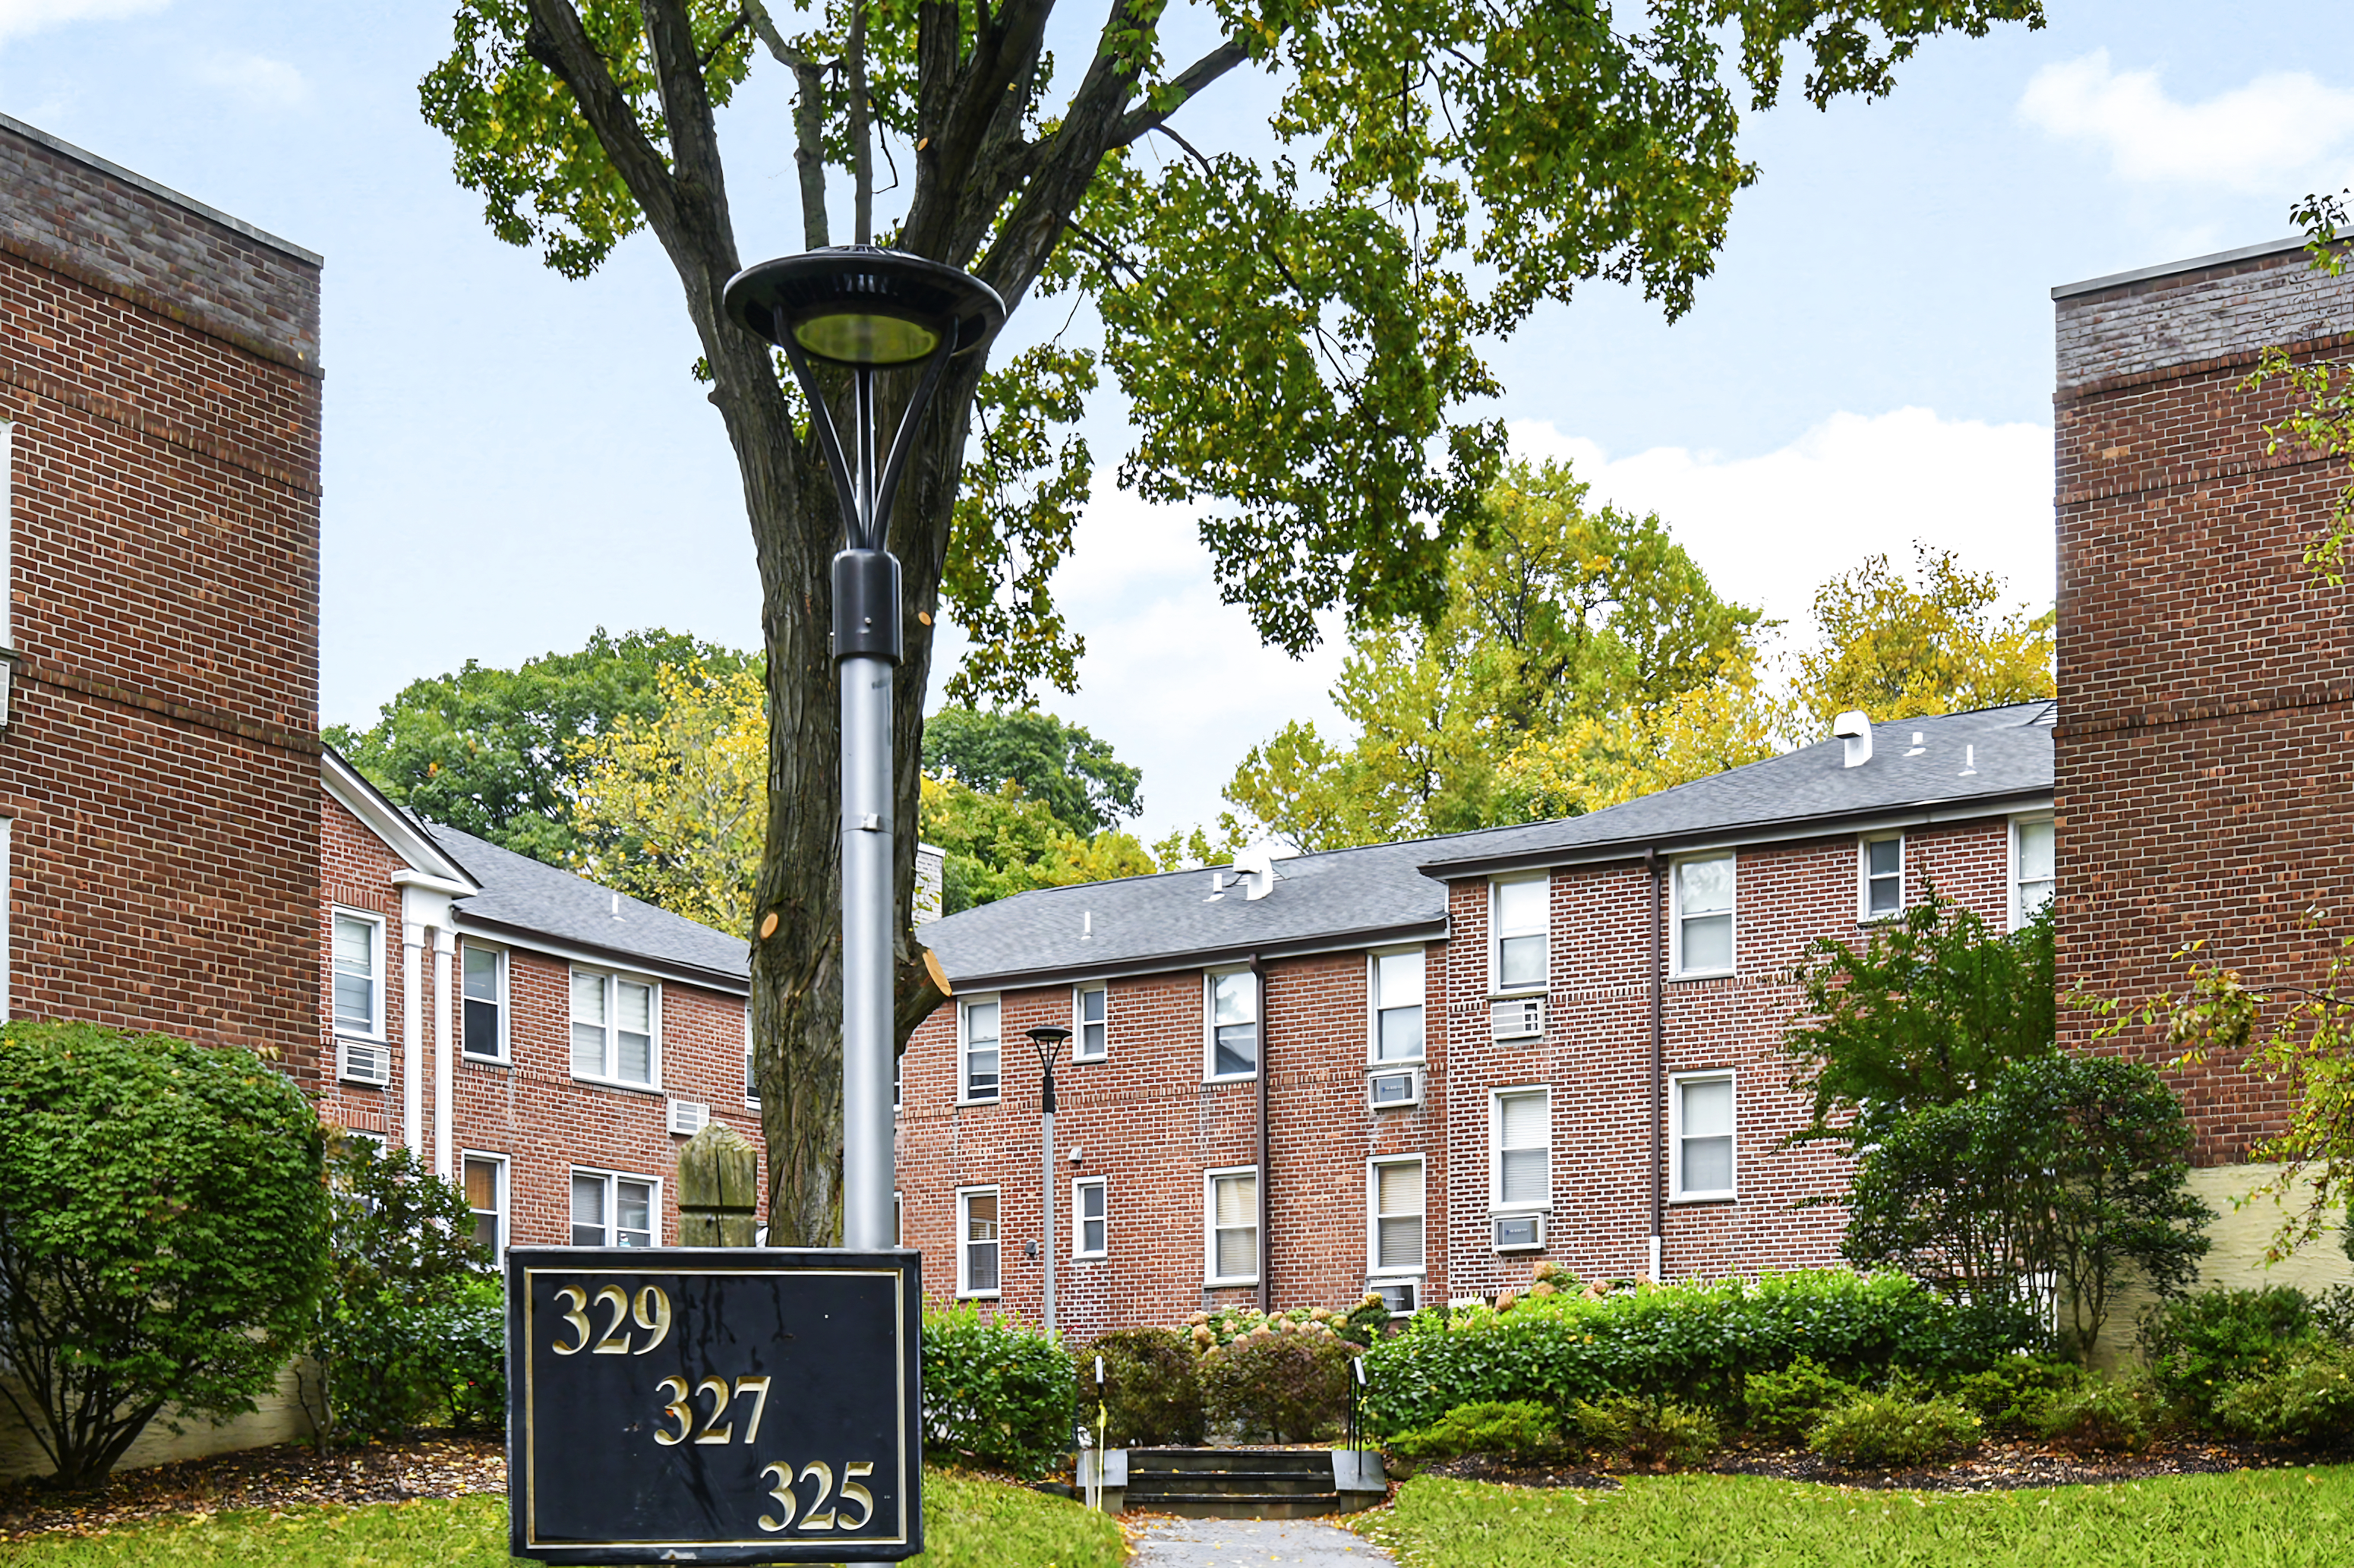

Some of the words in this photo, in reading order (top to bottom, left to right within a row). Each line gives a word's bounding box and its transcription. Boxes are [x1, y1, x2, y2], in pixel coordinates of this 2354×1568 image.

[552, 1284, 671, 1355] 329
[654, 1375, 771, 1446] 327
[758, 1460, 874, 1532] 325
